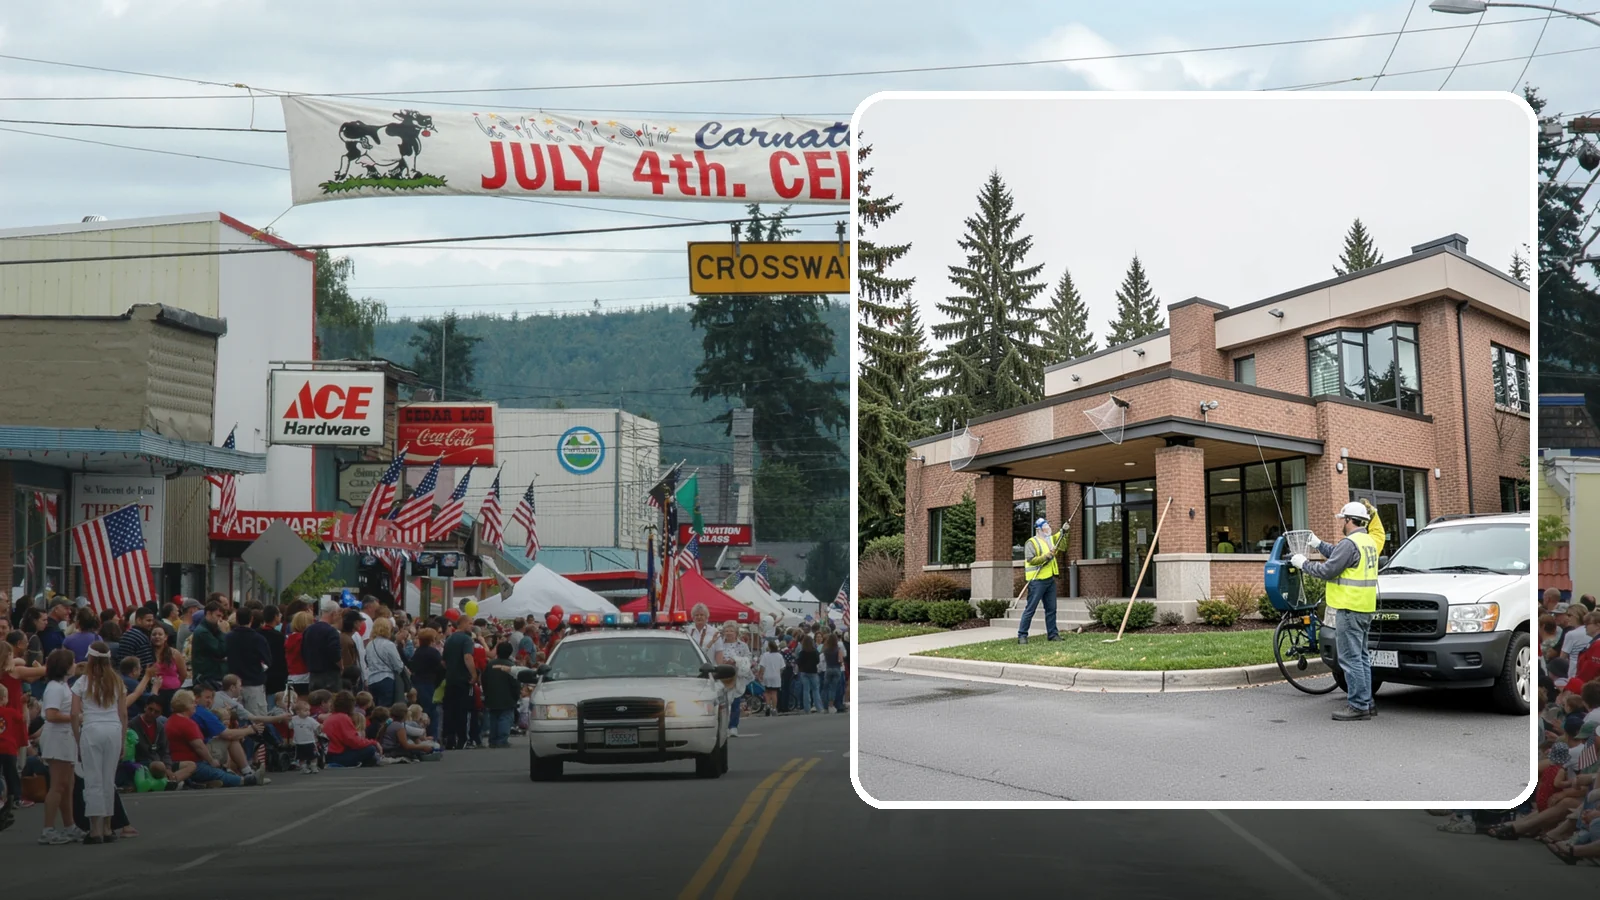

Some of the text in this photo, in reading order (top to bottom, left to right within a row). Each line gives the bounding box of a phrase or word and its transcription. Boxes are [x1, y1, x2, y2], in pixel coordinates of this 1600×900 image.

[481, 141, 604, 192] JULY
[632, 150, 746, 197] 4th.
[697, 254, 850, 279] CROSSWA
[282, 380, 373, 420] ACE
[406, 409, 485, 422] CEDAR LOG
[283, 421, 370, 436] Hardware
[416, 428, 477, 447] Coca-Cola
[354, 467, 386, 480] Simpl
[83, 484, 155, 495] St. Vincent de Paul
[212, 515, 331, 535] HARDARE
[688, 526, 741, 535] CRNATION
[699, 535, 730, 543] GLASS
